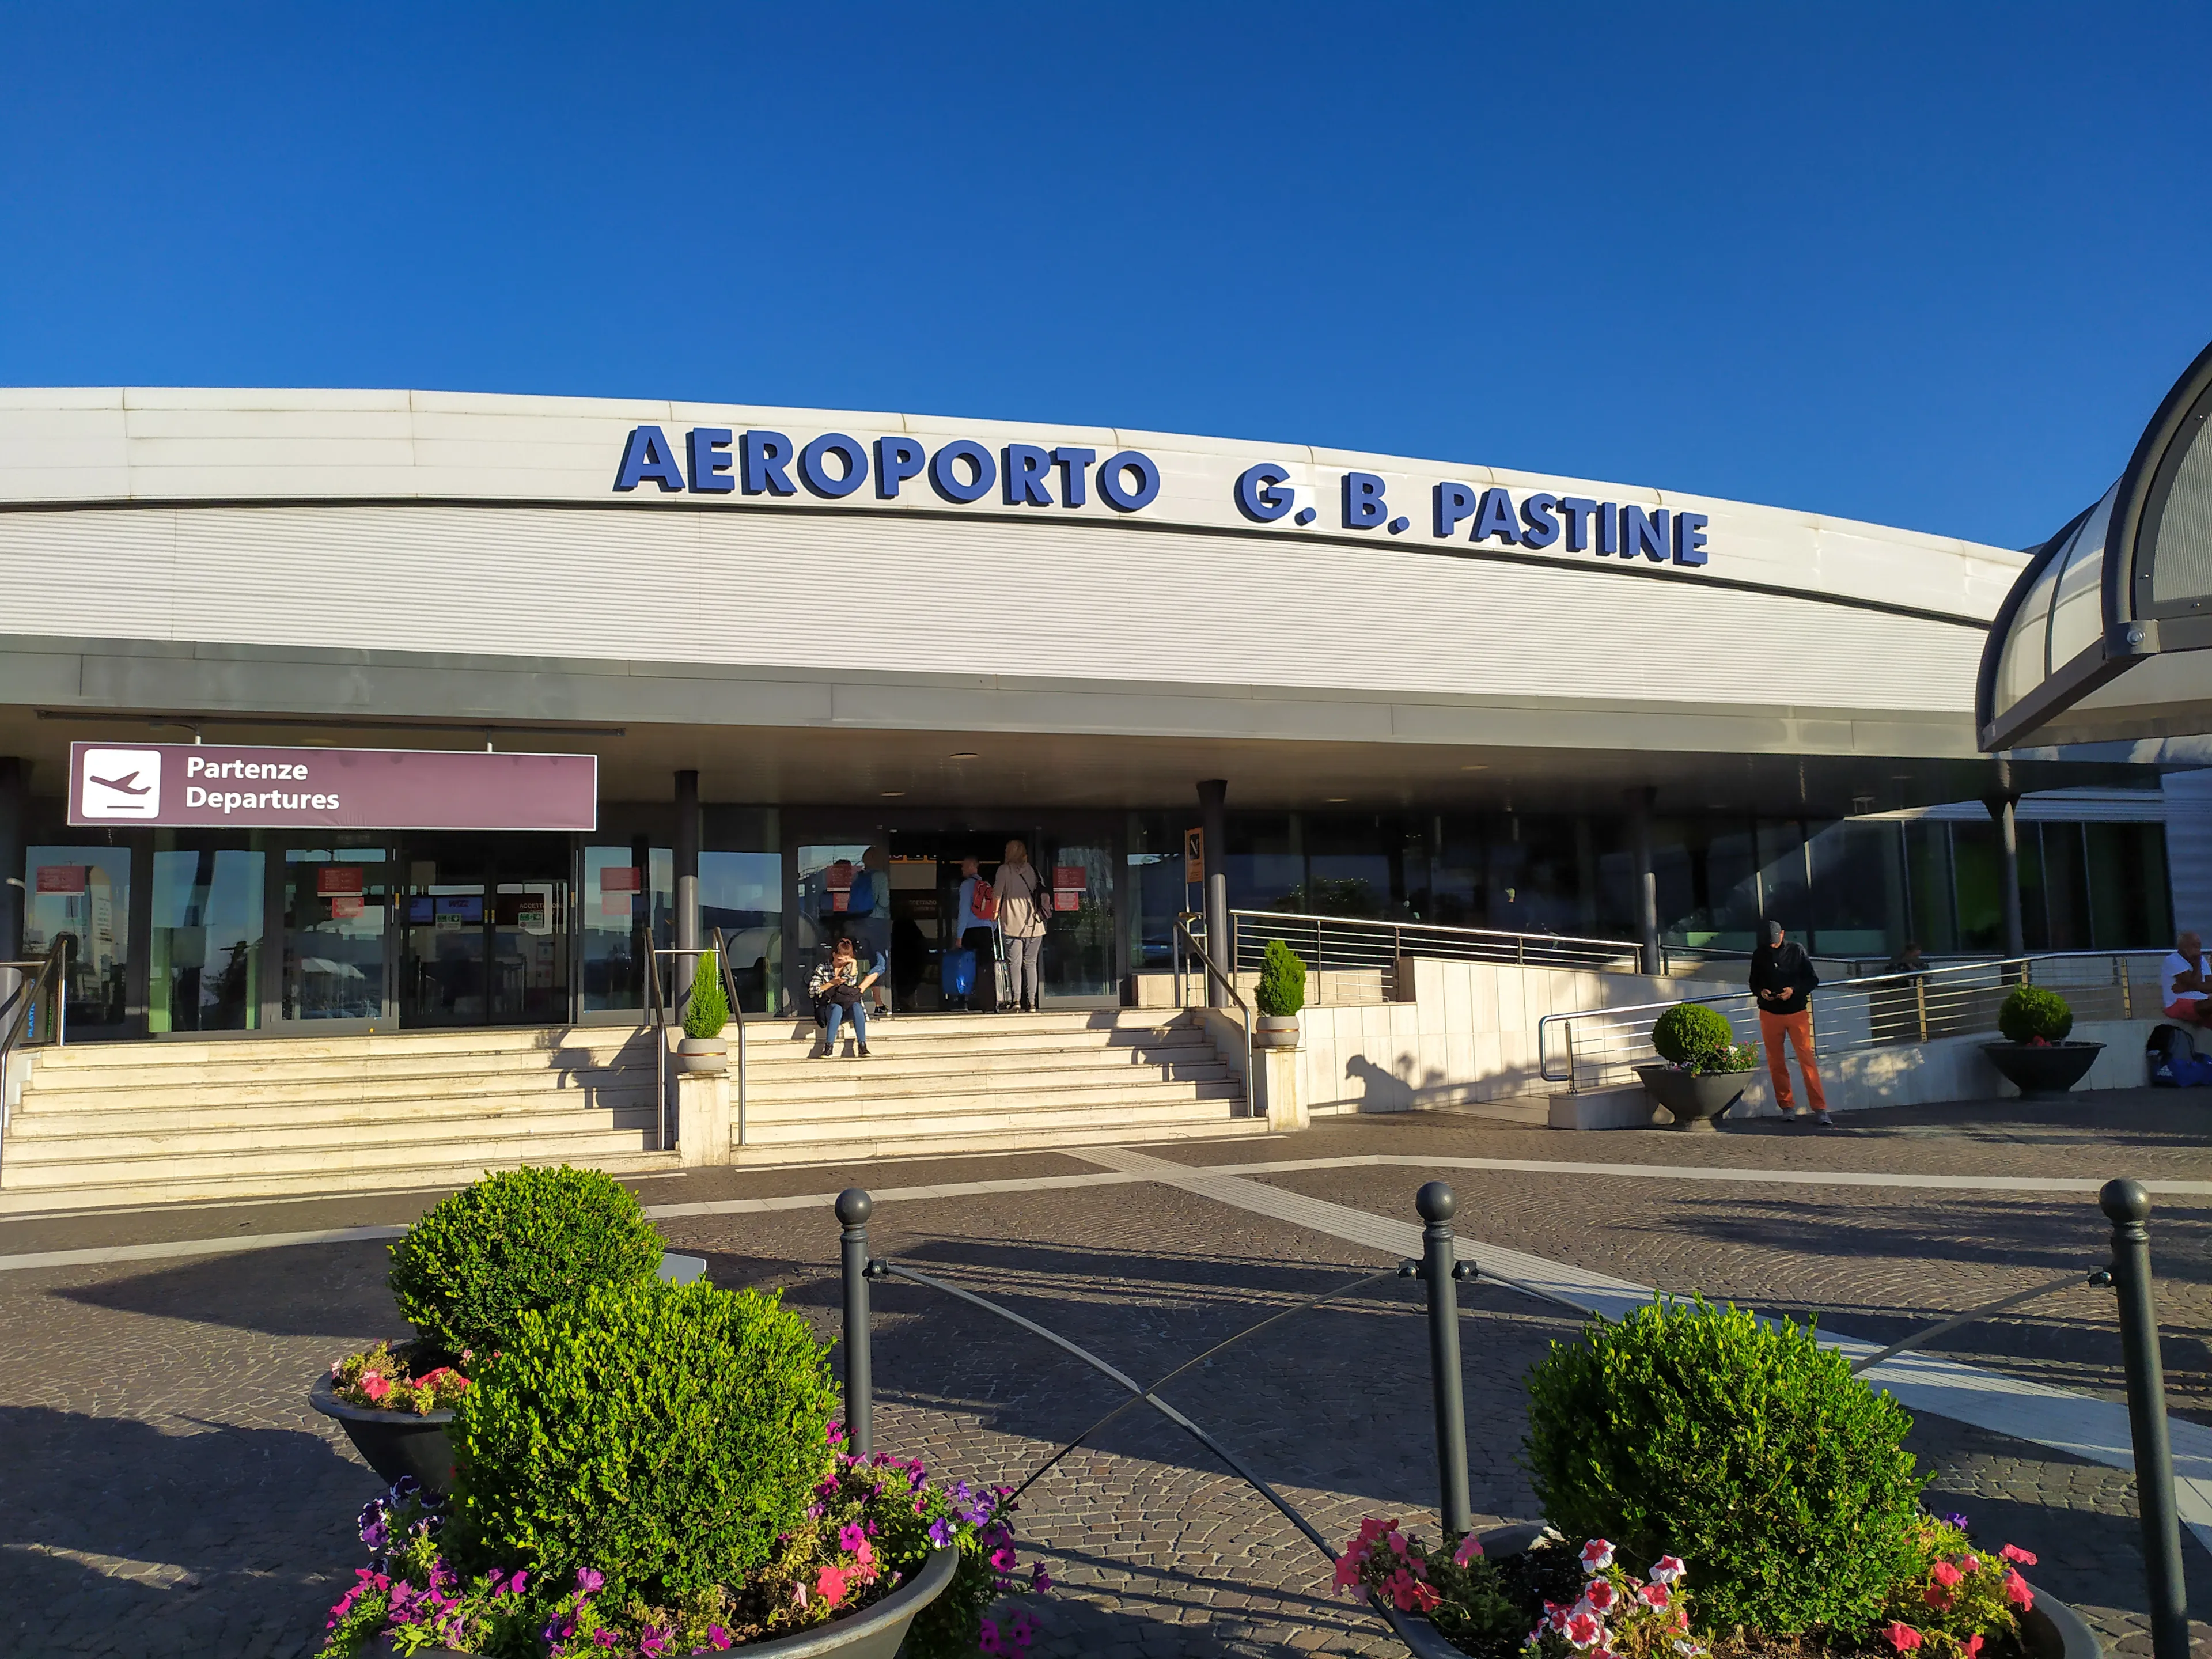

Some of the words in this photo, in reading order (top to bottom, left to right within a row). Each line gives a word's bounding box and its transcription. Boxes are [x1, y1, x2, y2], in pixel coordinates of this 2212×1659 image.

[612, 426, 1160, 512] AEROPORTO
[1234, 463, 1317, 526] G.
[1342, 472, 1410, 534] B.
[1433, 482, 1708, 567] PASTINE
[187, 757, 308, 780] Partenze
[186, 786, 339, 813] Departures
